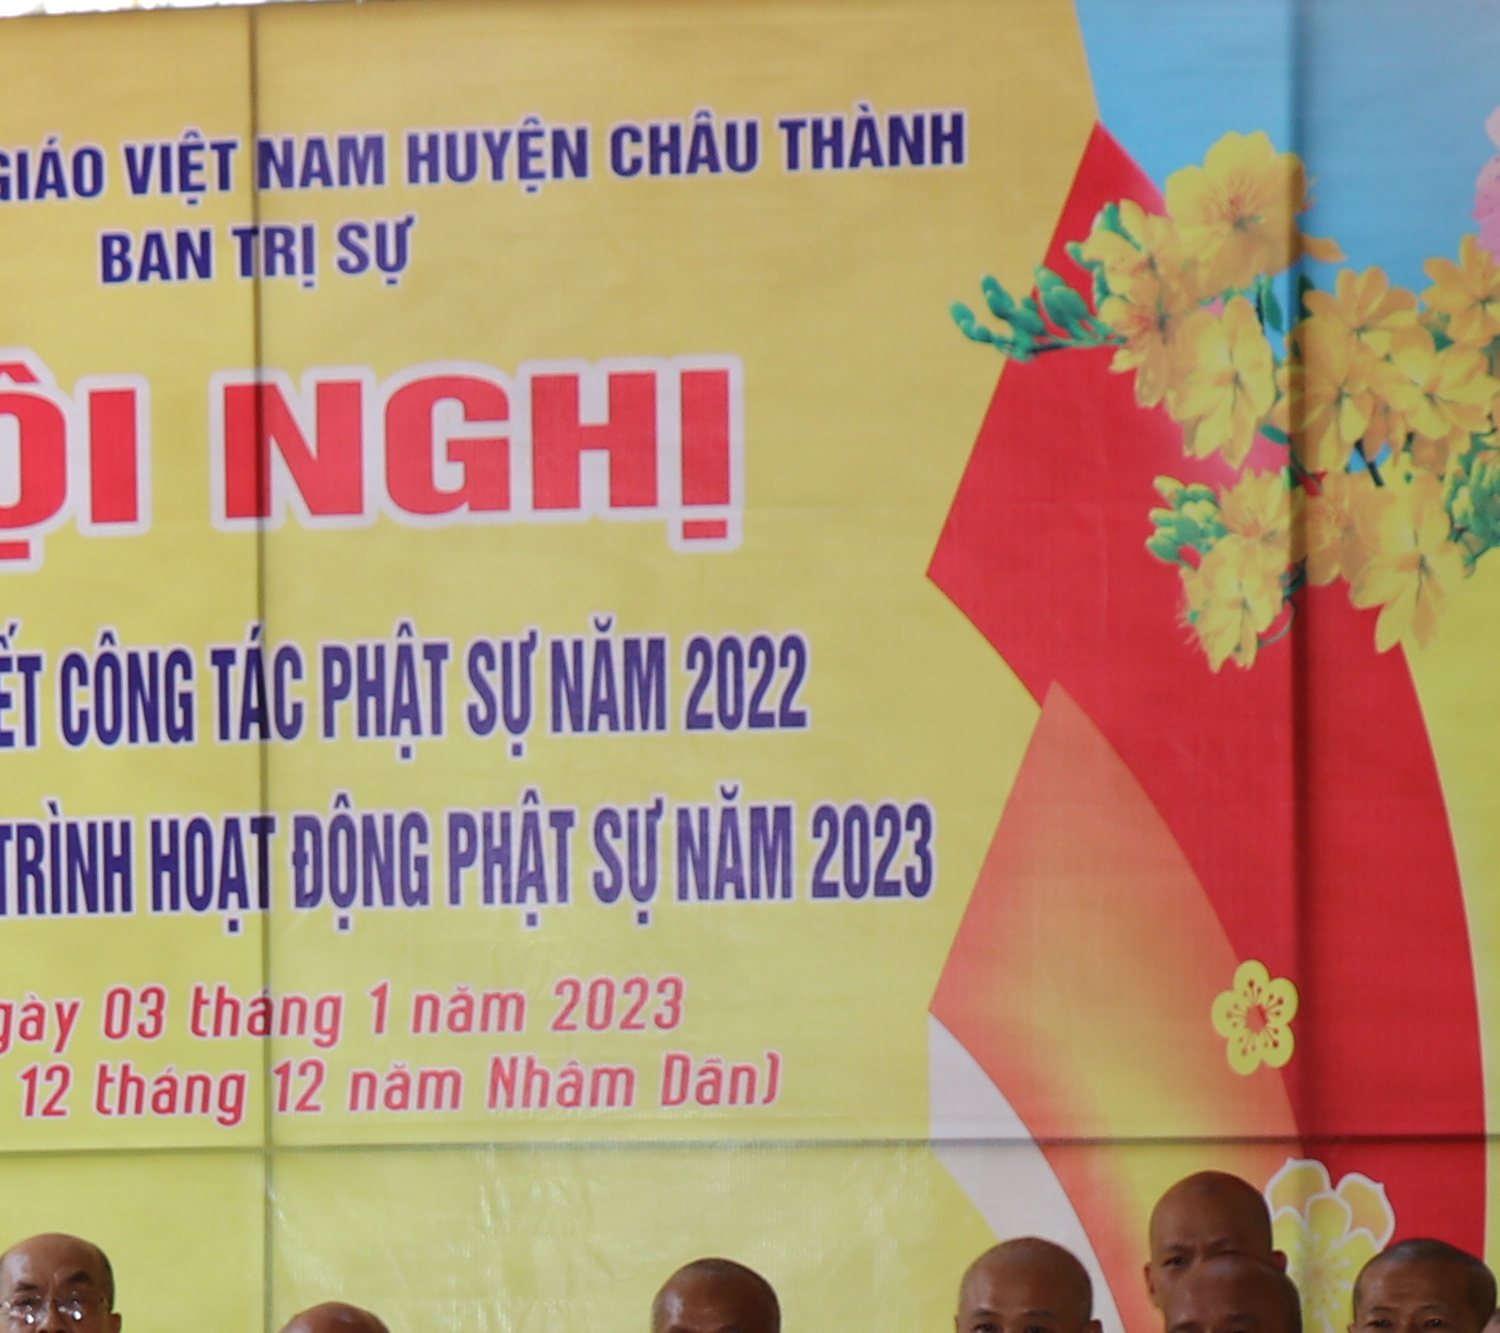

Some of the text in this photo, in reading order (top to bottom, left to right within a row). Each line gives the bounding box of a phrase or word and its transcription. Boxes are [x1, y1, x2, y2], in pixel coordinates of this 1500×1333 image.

[124, 130, 238, 205] VIỆT
[256, 135, 385, 190] NAM
[407, 117, 588, 193] HUYỆN
[611, 110, 758, 178] CHÂU
[779, 104, 965, 171] THÀNH
[101, 215, 414, 288] BAN TRỊ SỰ
[222, 368, 732, 541] NGHỊ
[60, 631, 194, 747] CÔNG
[211, 625, 303, 741] TÁC
[323, 622, 449, 759] PHẬT
[467, 630, 537, 757] SỰ
[551, 617, 666, 733] NĂM
[686, 634, 807, 731] 2022
[151, 815, 276, 933] HOẠT
[292, 793, 429, 930] ĐỘNG
[448, 789, 575, 926] PHẬT
[593, 797, 664, 925] SỰ
[677, 785, 792, 901] NĂM
[811, 802, 933, 900] 2023
[104, 986, 166, 1040] 03
[190, 985, 342, 1048] tháng
[371, 983, 388, 1034] 1
[412, 986, 526, 1033] năm
[552, 976, 683, 1031] 2023
[21, 1063, 71, 1117] 12
[95, 1063, 246, 1127] tháng
[274, 1059, 325, 1112] 12
[348, 1063, 462, 1112] năm
[488, 1056, 635, 1108] Nhâm
